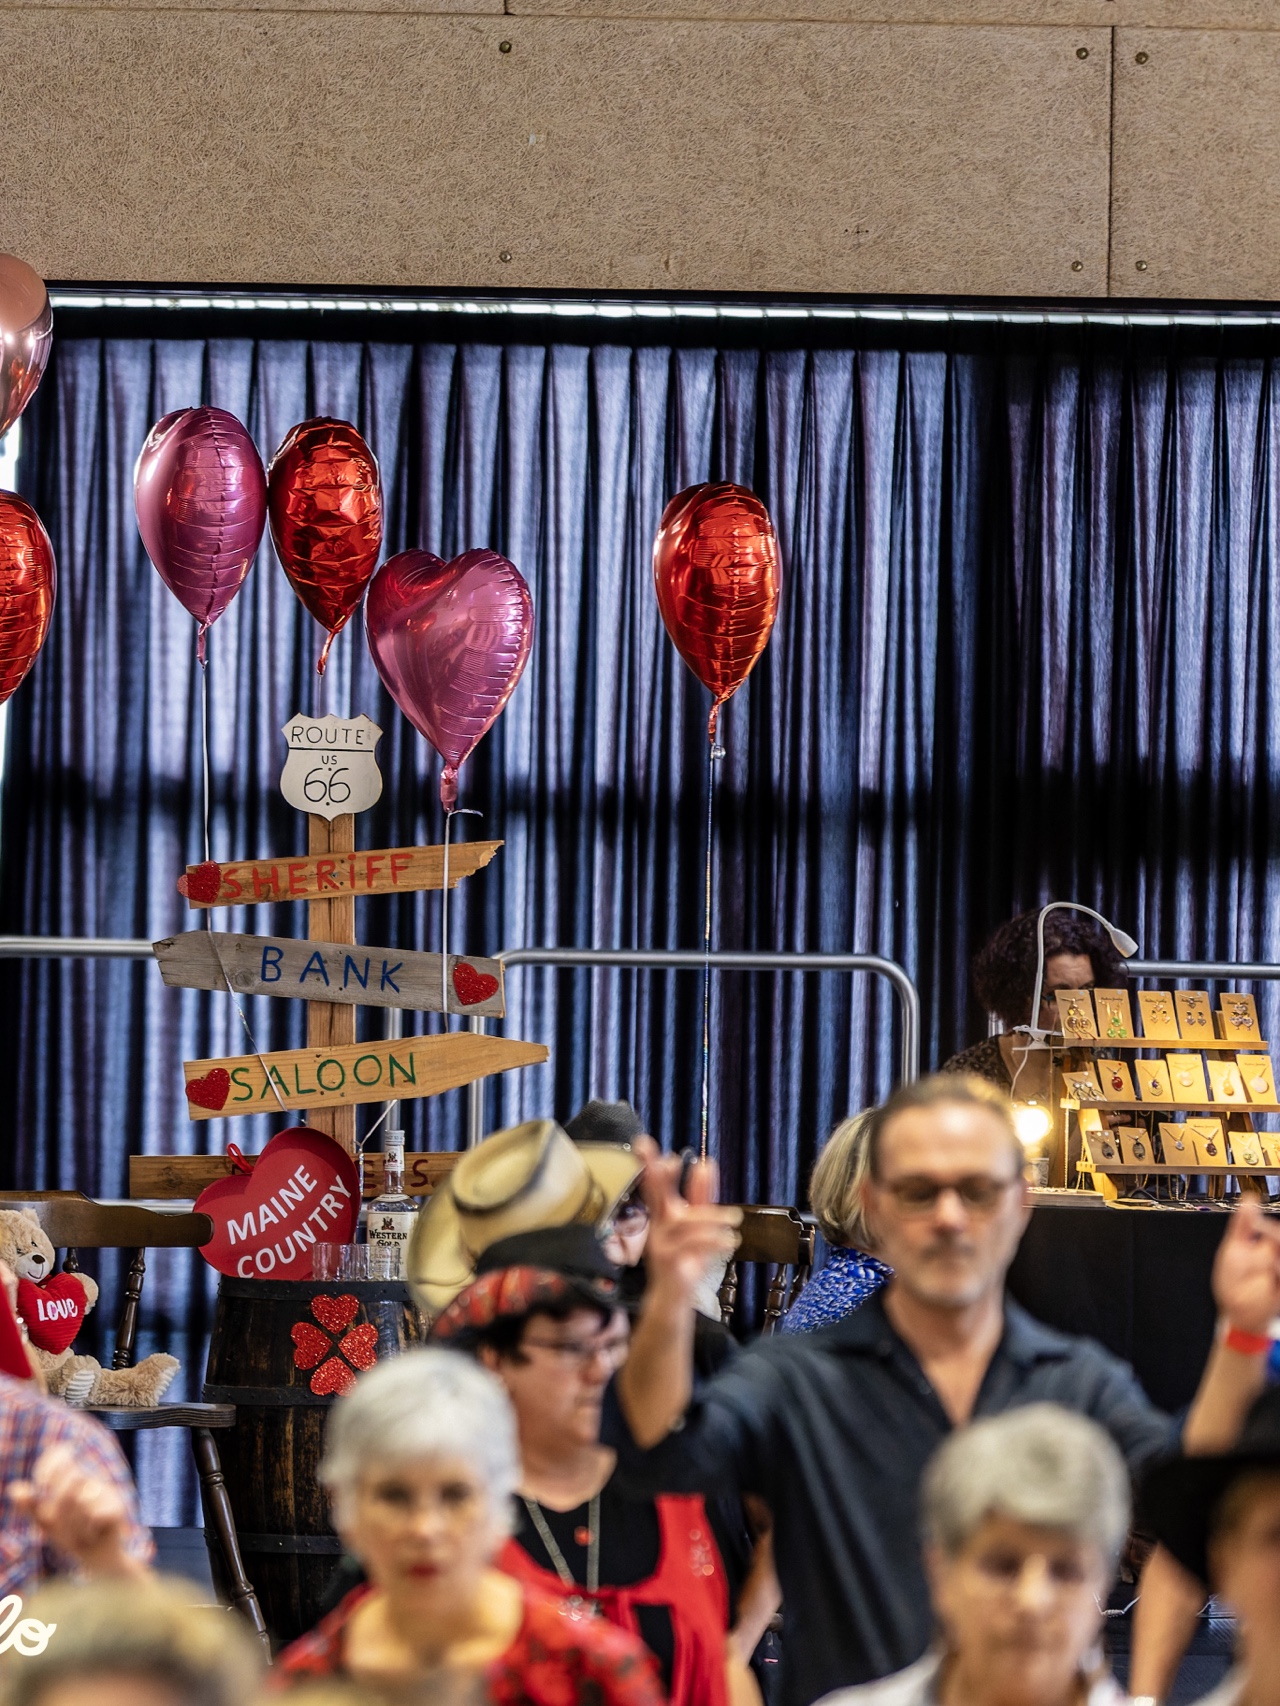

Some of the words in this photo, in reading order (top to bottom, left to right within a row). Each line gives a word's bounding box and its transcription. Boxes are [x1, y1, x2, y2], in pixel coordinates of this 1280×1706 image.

[291, 725, 365, 745] ROUTE
[321, 755, 338, 765] US
[303, 767, 352, 804] 66
[260, 945, 404, 994] BANK
[230, 1052, 417, 1102] SALOON
[226, 1164, 318, 1246] MAINE
[237, 1174, 352, 1279] COUNTRY
[369, 1229, 408, 1240] WESTERN
